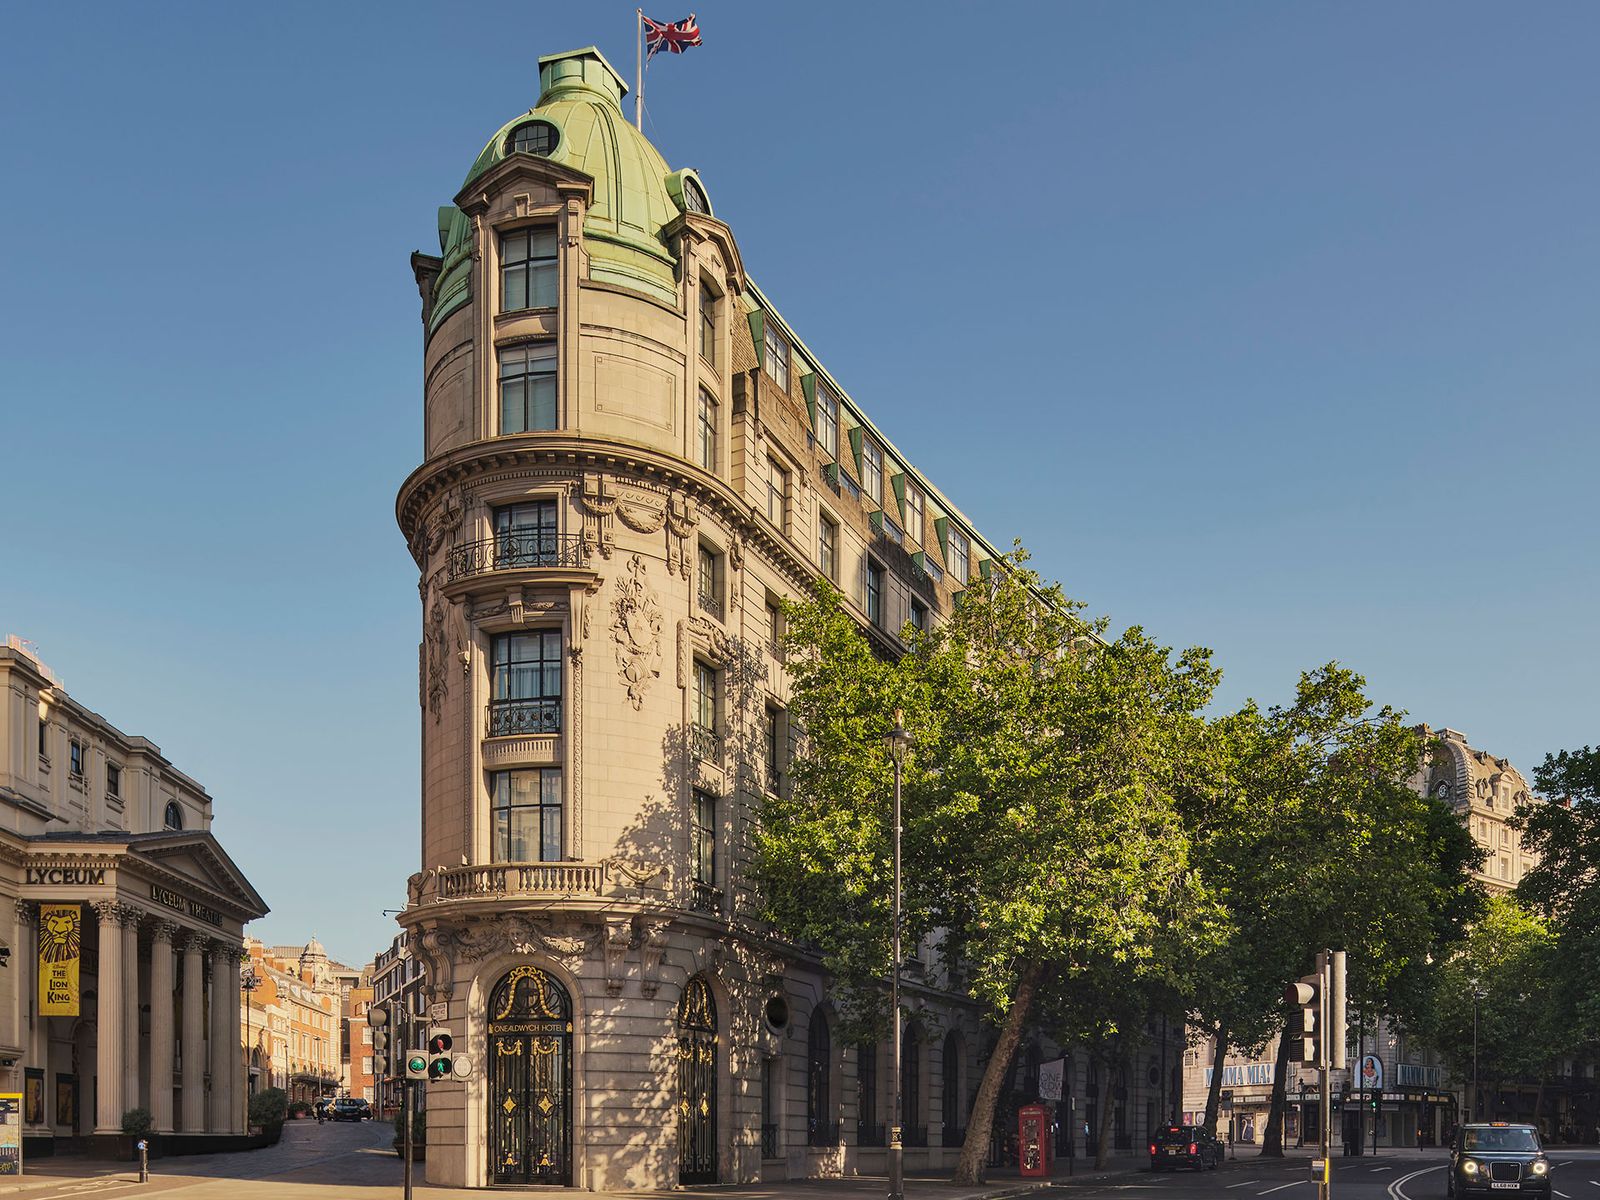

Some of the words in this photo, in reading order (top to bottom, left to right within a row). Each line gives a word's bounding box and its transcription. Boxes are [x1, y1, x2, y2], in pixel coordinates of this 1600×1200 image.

[26, 868, 105, 885] LYCEUM
[151, 885, 187, 912] LYCEUM
[190, 902, 224, 928] THEATRE
[49, 979, 68, 990] LION
[47, 991, 70, 1004] KING
[541, 1023, 563, 1032] HOTEL
[1205, 1066, 1244, 1087] MMMA
[1246, 1064, 1271, 1085] MIA!
